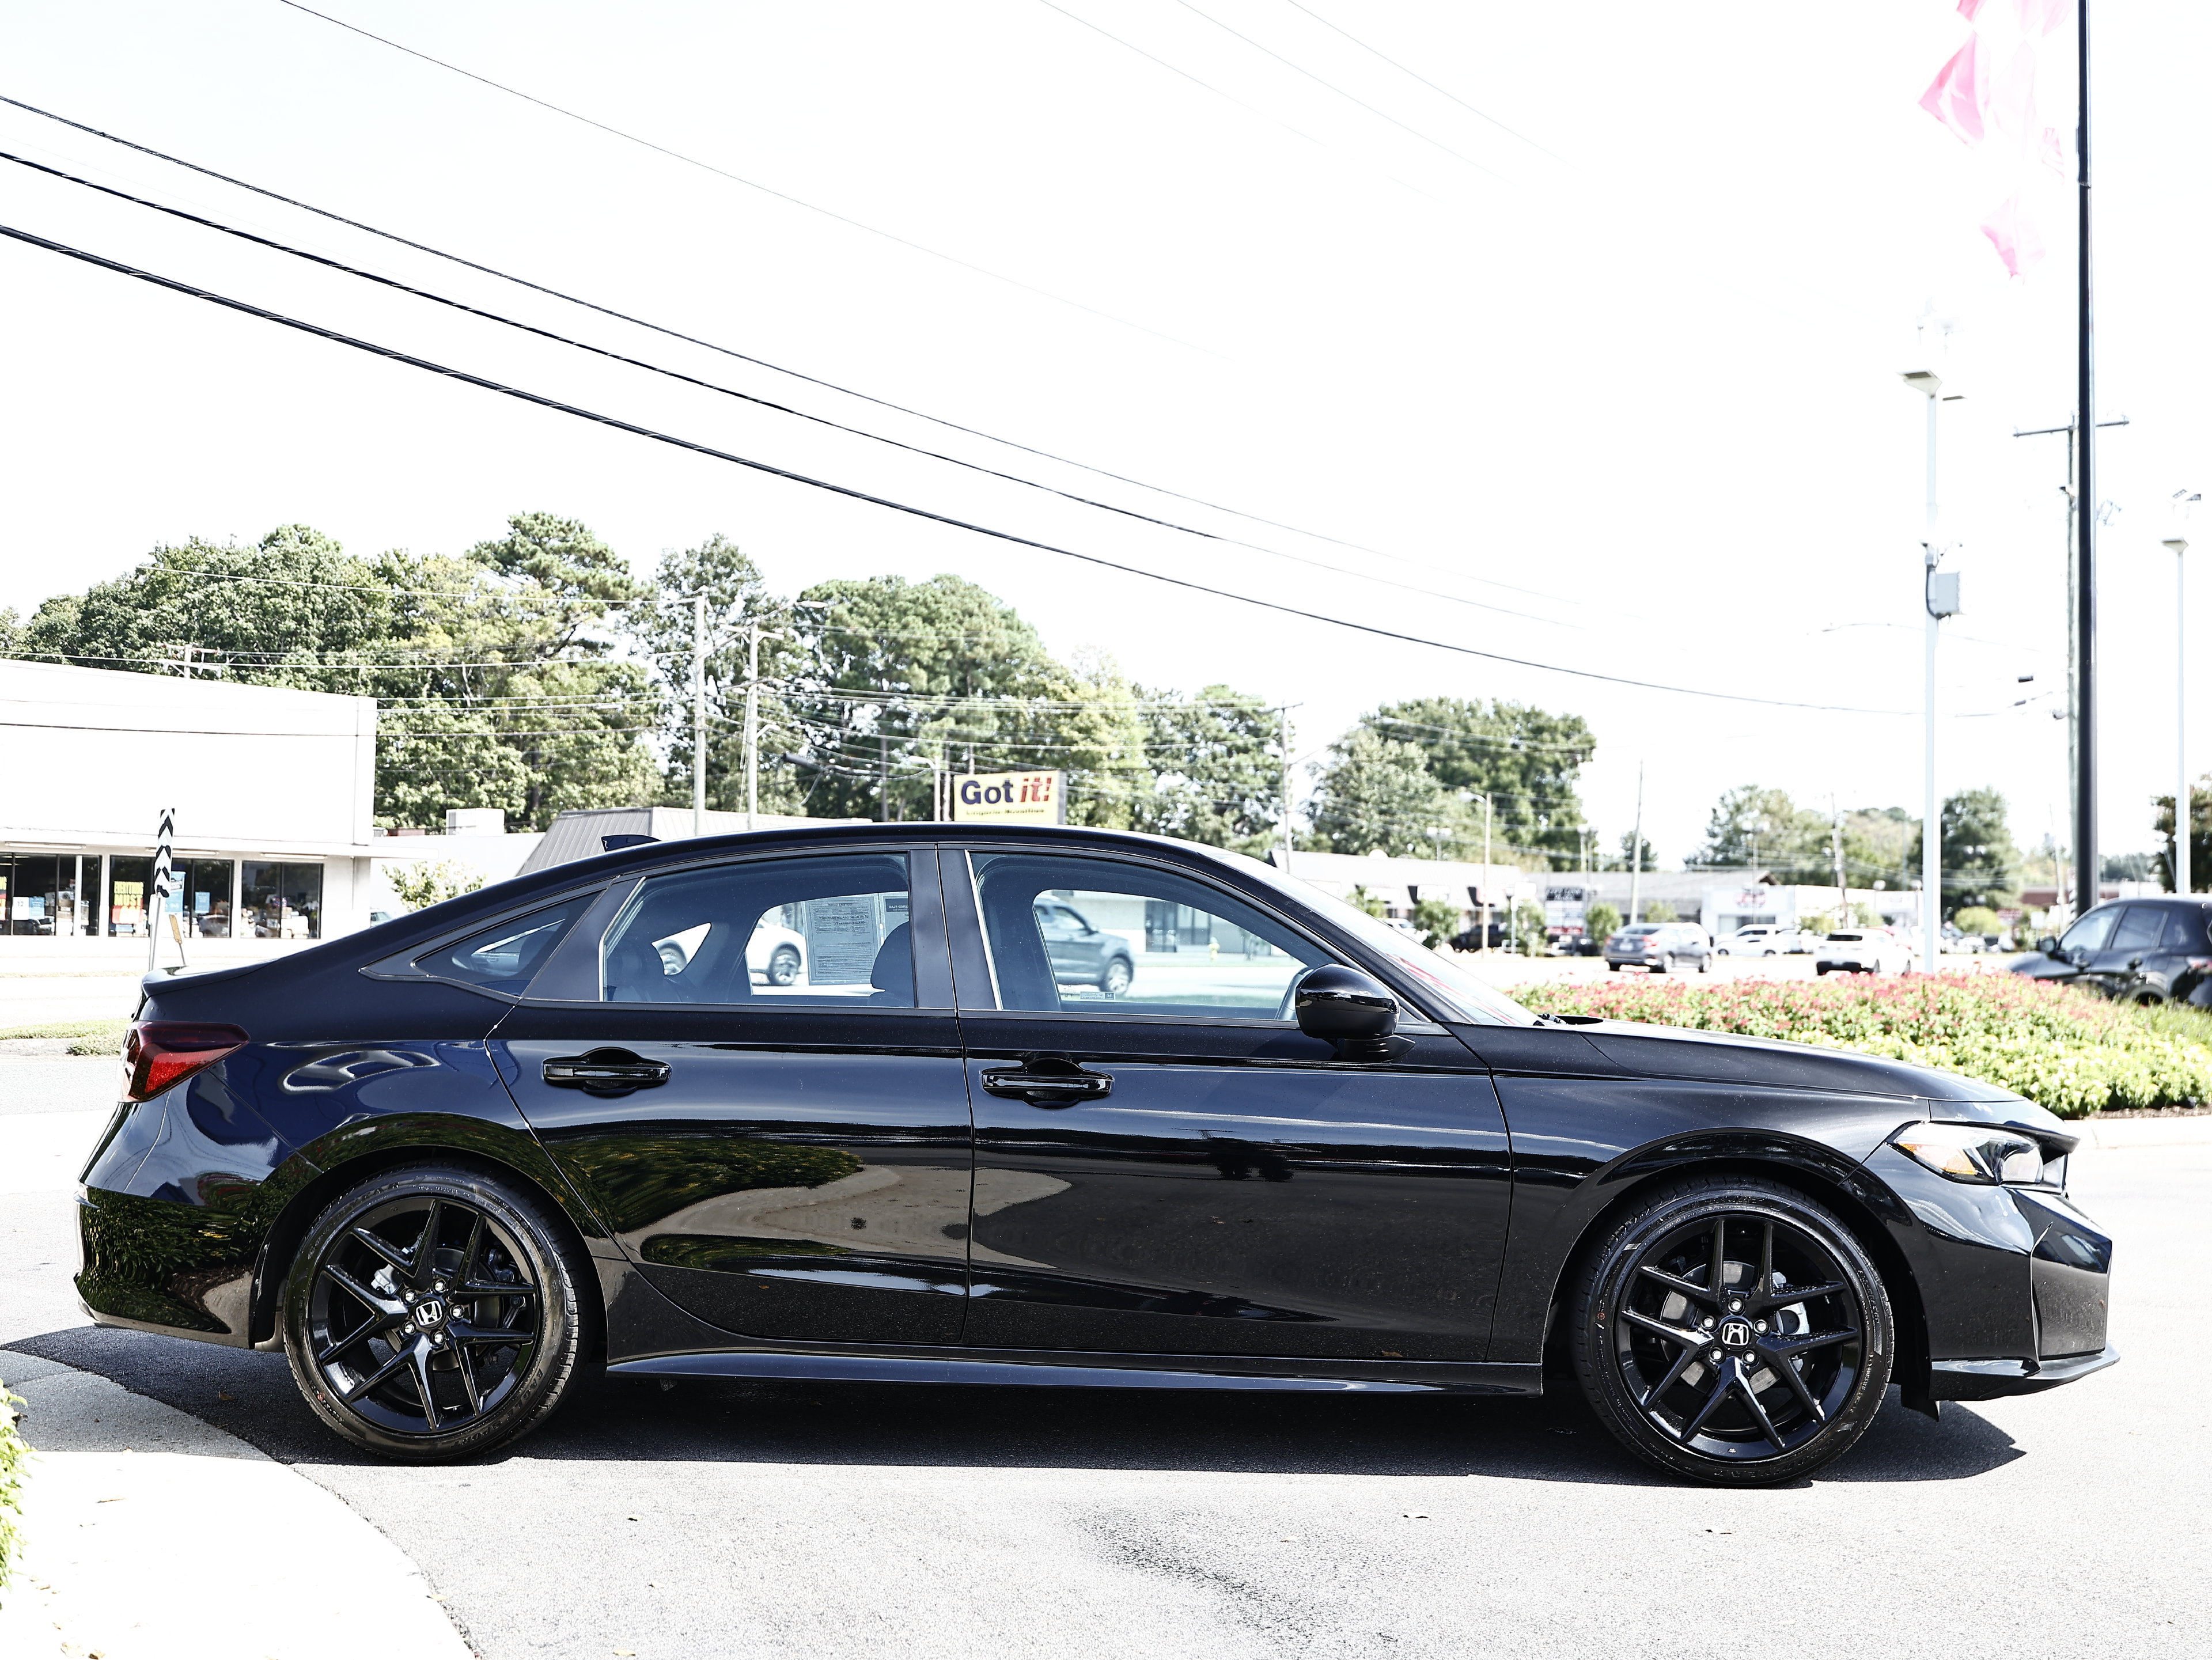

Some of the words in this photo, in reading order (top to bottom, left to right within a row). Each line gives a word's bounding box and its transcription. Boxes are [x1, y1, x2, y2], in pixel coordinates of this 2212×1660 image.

[961, 778, 1014, 805] Got
[1020, 776, 1052, 803] it!
[114, 881, 144, 895] EVERYTHING
[114, 895, 142, 906] MUST
[506, 1369, 543, 1420] EAGLE
[451, 1421, 501, 1446] SPORT
